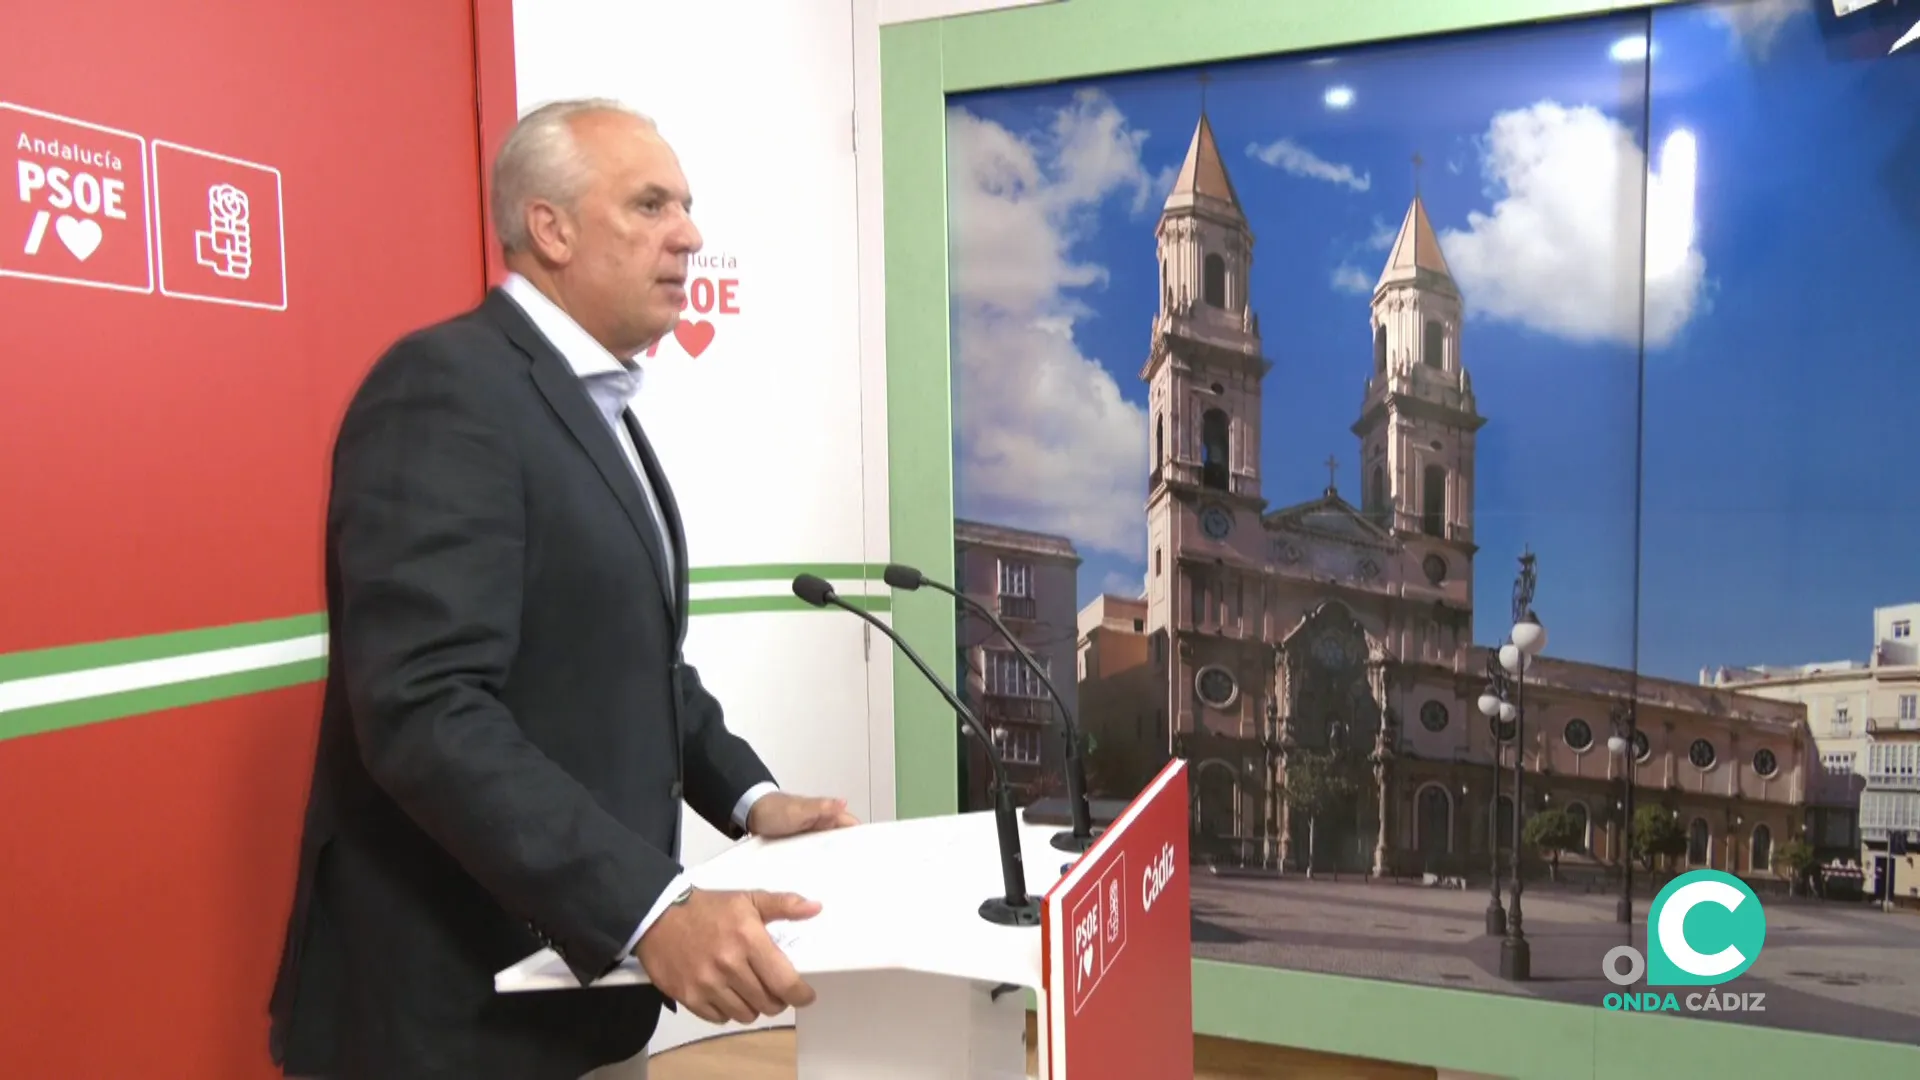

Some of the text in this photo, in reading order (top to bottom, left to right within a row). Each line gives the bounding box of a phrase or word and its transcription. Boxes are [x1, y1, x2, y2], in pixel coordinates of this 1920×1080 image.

[17, 132, 122, 170] Andalucía
[17, 159, 127, 220] PSOE
[691, 252, 737, 269] lucía
[1142, 841, 1175, 912] Cádiz
[1075, 904, 1098, 956] PSOE
